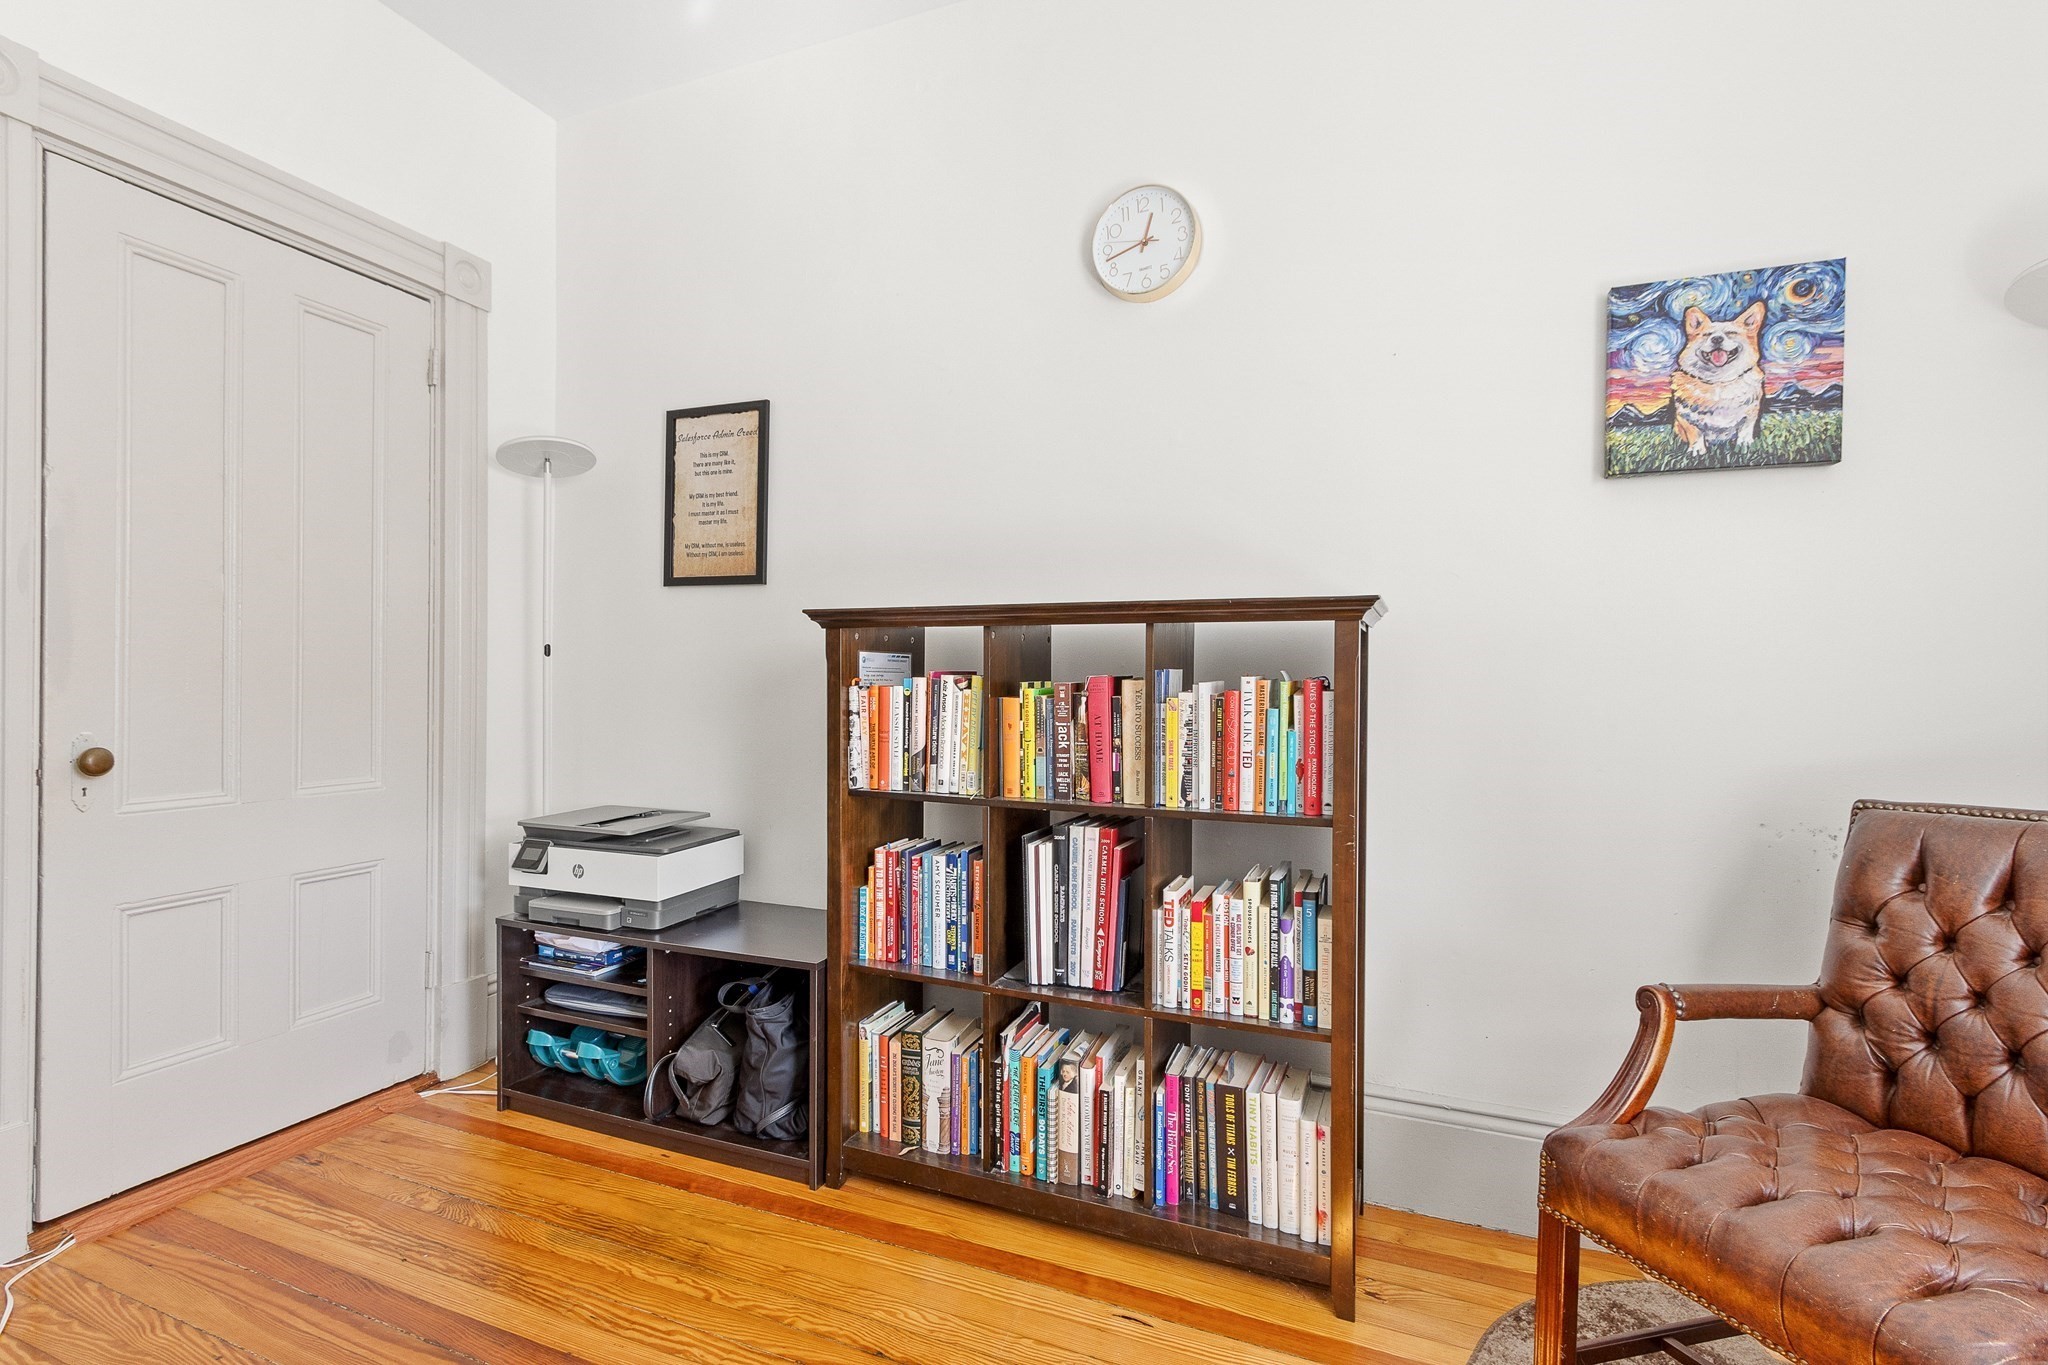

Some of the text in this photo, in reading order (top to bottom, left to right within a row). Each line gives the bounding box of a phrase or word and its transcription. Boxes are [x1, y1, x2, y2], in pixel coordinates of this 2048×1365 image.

[1136, 197, 1150, 214] 12
[1120, 206, 1130, 223] 11
[1170, 207, 1182, 225] 2
[1105, 223, 1123, 241] 10
[1177, 225, 1189, 242] 3
[1102, 244, 1113, 260] 9
[1173, 246, 1185, 261] 4
[1108, 262, 1119, 278] 8
[1160, 263, 1171, 280] 5
[1122, 272, 1133, 288] 7
[1141, 273, 1152, 289] 6
[676, 431, 711, 445] Salesforce
[712, 429, 735, 440] Admin
[1309, 703, 1316, 712] OF
[961, 693, 970, 761] HEAVY
[1134, 688, 1143, 761] YEAR TO SUCCESS
[1242, 690, 1252, 769] TALK LIKE TED
[1056, 721, 1070, 748] jack
[1094, 714, 1103, 763] AT HOME
[1226, 741, 1236, 765] GOD
[572, 863, 585, 879] hp
[876, 870, 883, 878] TO
[876, 879, 883, 888] DO
[1099, 878, 1107, 896] HIGH
[1270, 883, 1278, 891] NO
[1270, 891, 1278, 909] FORMS.
[1098, 898, 1106, 926] SCHOOL
[1306, 908, 1312, 918] 5
[1164, 899, 1174, 962] TED TALKS
[1270, 932, 1278, 940] NO
[1095, 937, 1104, 969] Ramparts
[1270, 940, 1278, 953] COLD
[1270, 953, 1278, 968] CALLS.
[1012, 1079, 1020, 1107] CREATIVE
[1012, 1108, 1020, 1127] CURVE
[1248, 1097, 1257, 1122] TINY
[1039, 1119, 1045, 1130] 90
[1225, 1093, 1235, 1145] TOOLS OF TITANS
[1167, 1111, 1177, 1175] The Richer Sex
[1227, 1157, 1237, 1196] TIM FERRISS
